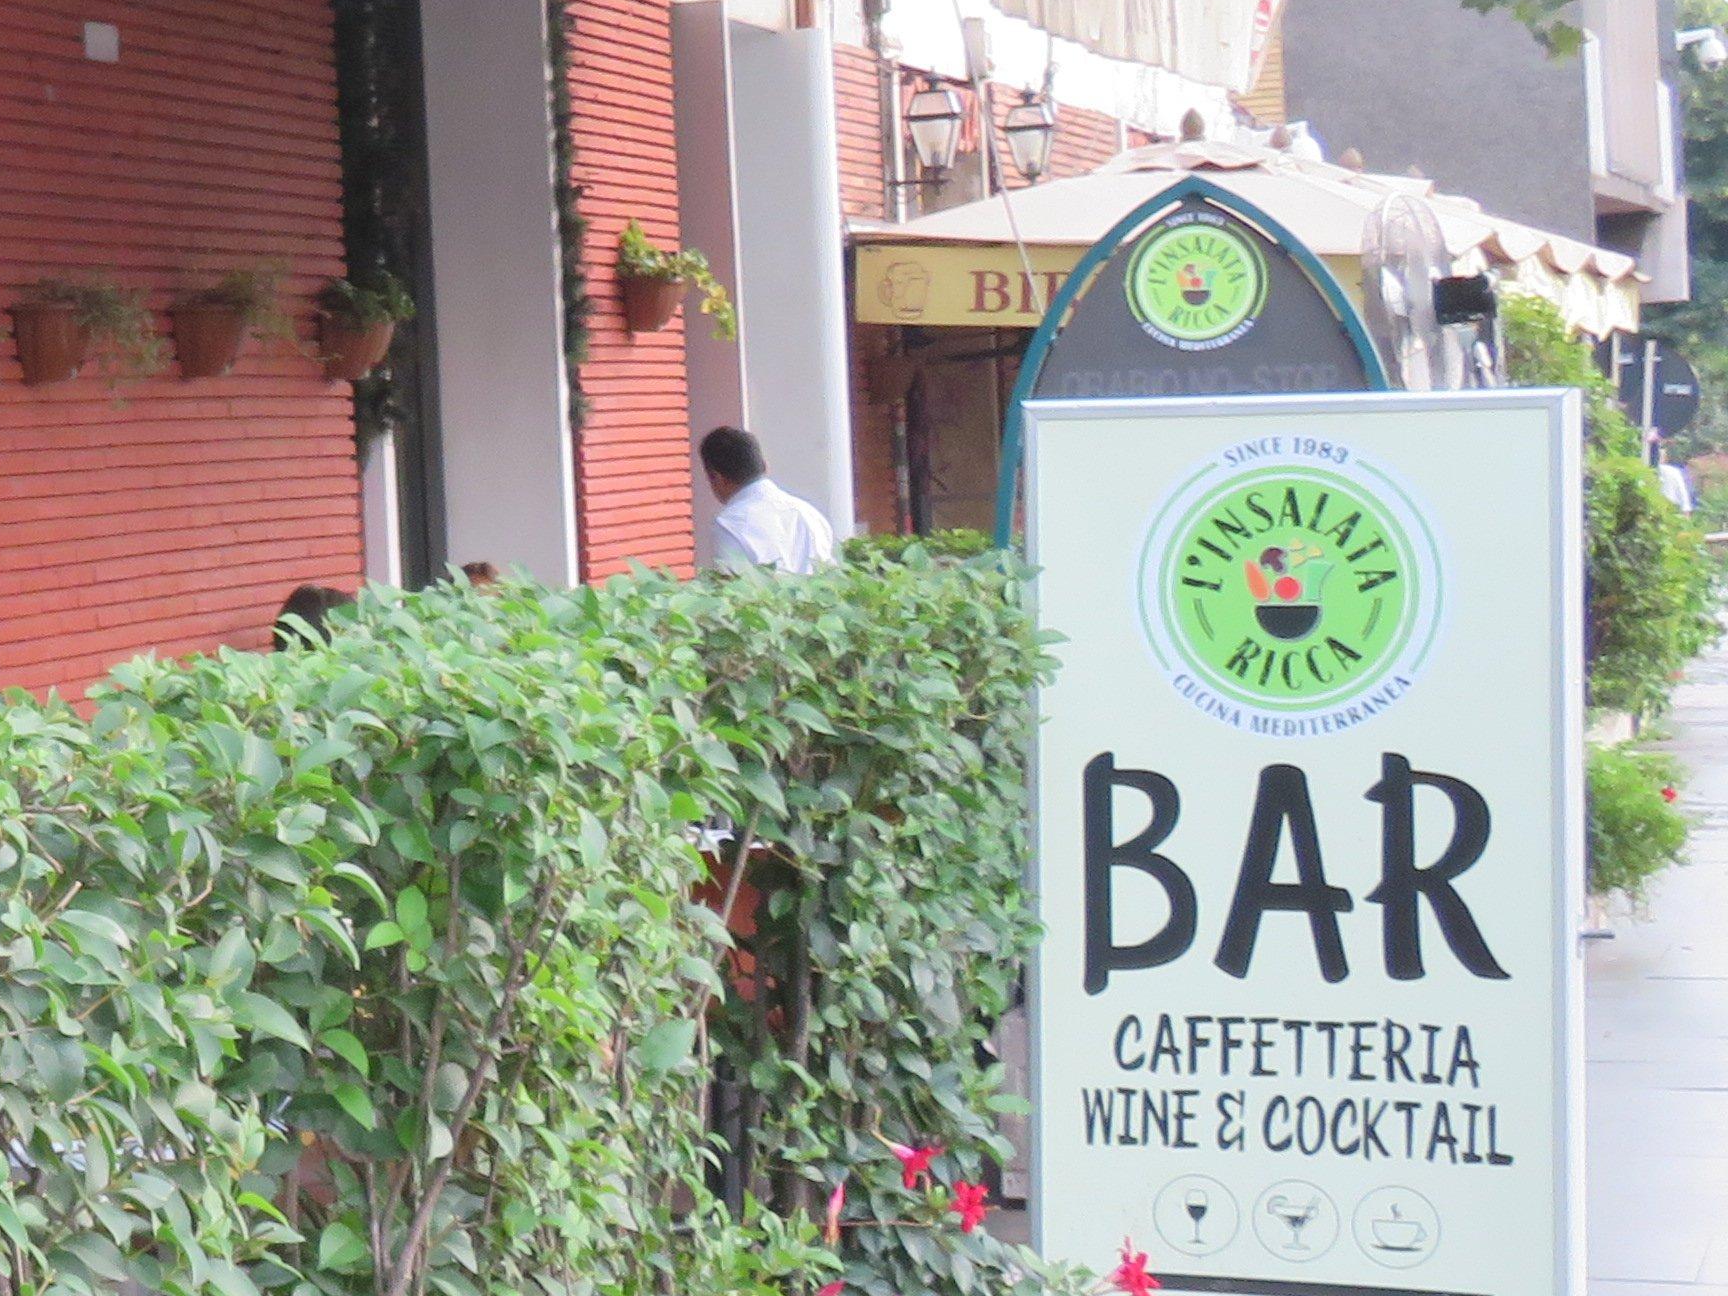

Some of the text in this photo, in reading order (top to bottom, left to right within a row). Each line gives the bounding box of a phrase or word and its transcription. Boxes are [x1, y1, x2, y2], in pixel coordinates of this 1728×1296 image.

[1222, 436, 1350, 467] SINCE 1983
[1181, 487, 1398, 593] L'INSALATA
[1225, 635, 1363, 691] RICCA
[1173, 673, 1413, 738] CUCINA MEDITERRANEA
[1083, 750, 1512, 996] BAR
[1114, 1013, 1480, 1088] CAFFETTERIA
[1082, 1087, 1515, 1167] WINE & COCKTAIL
